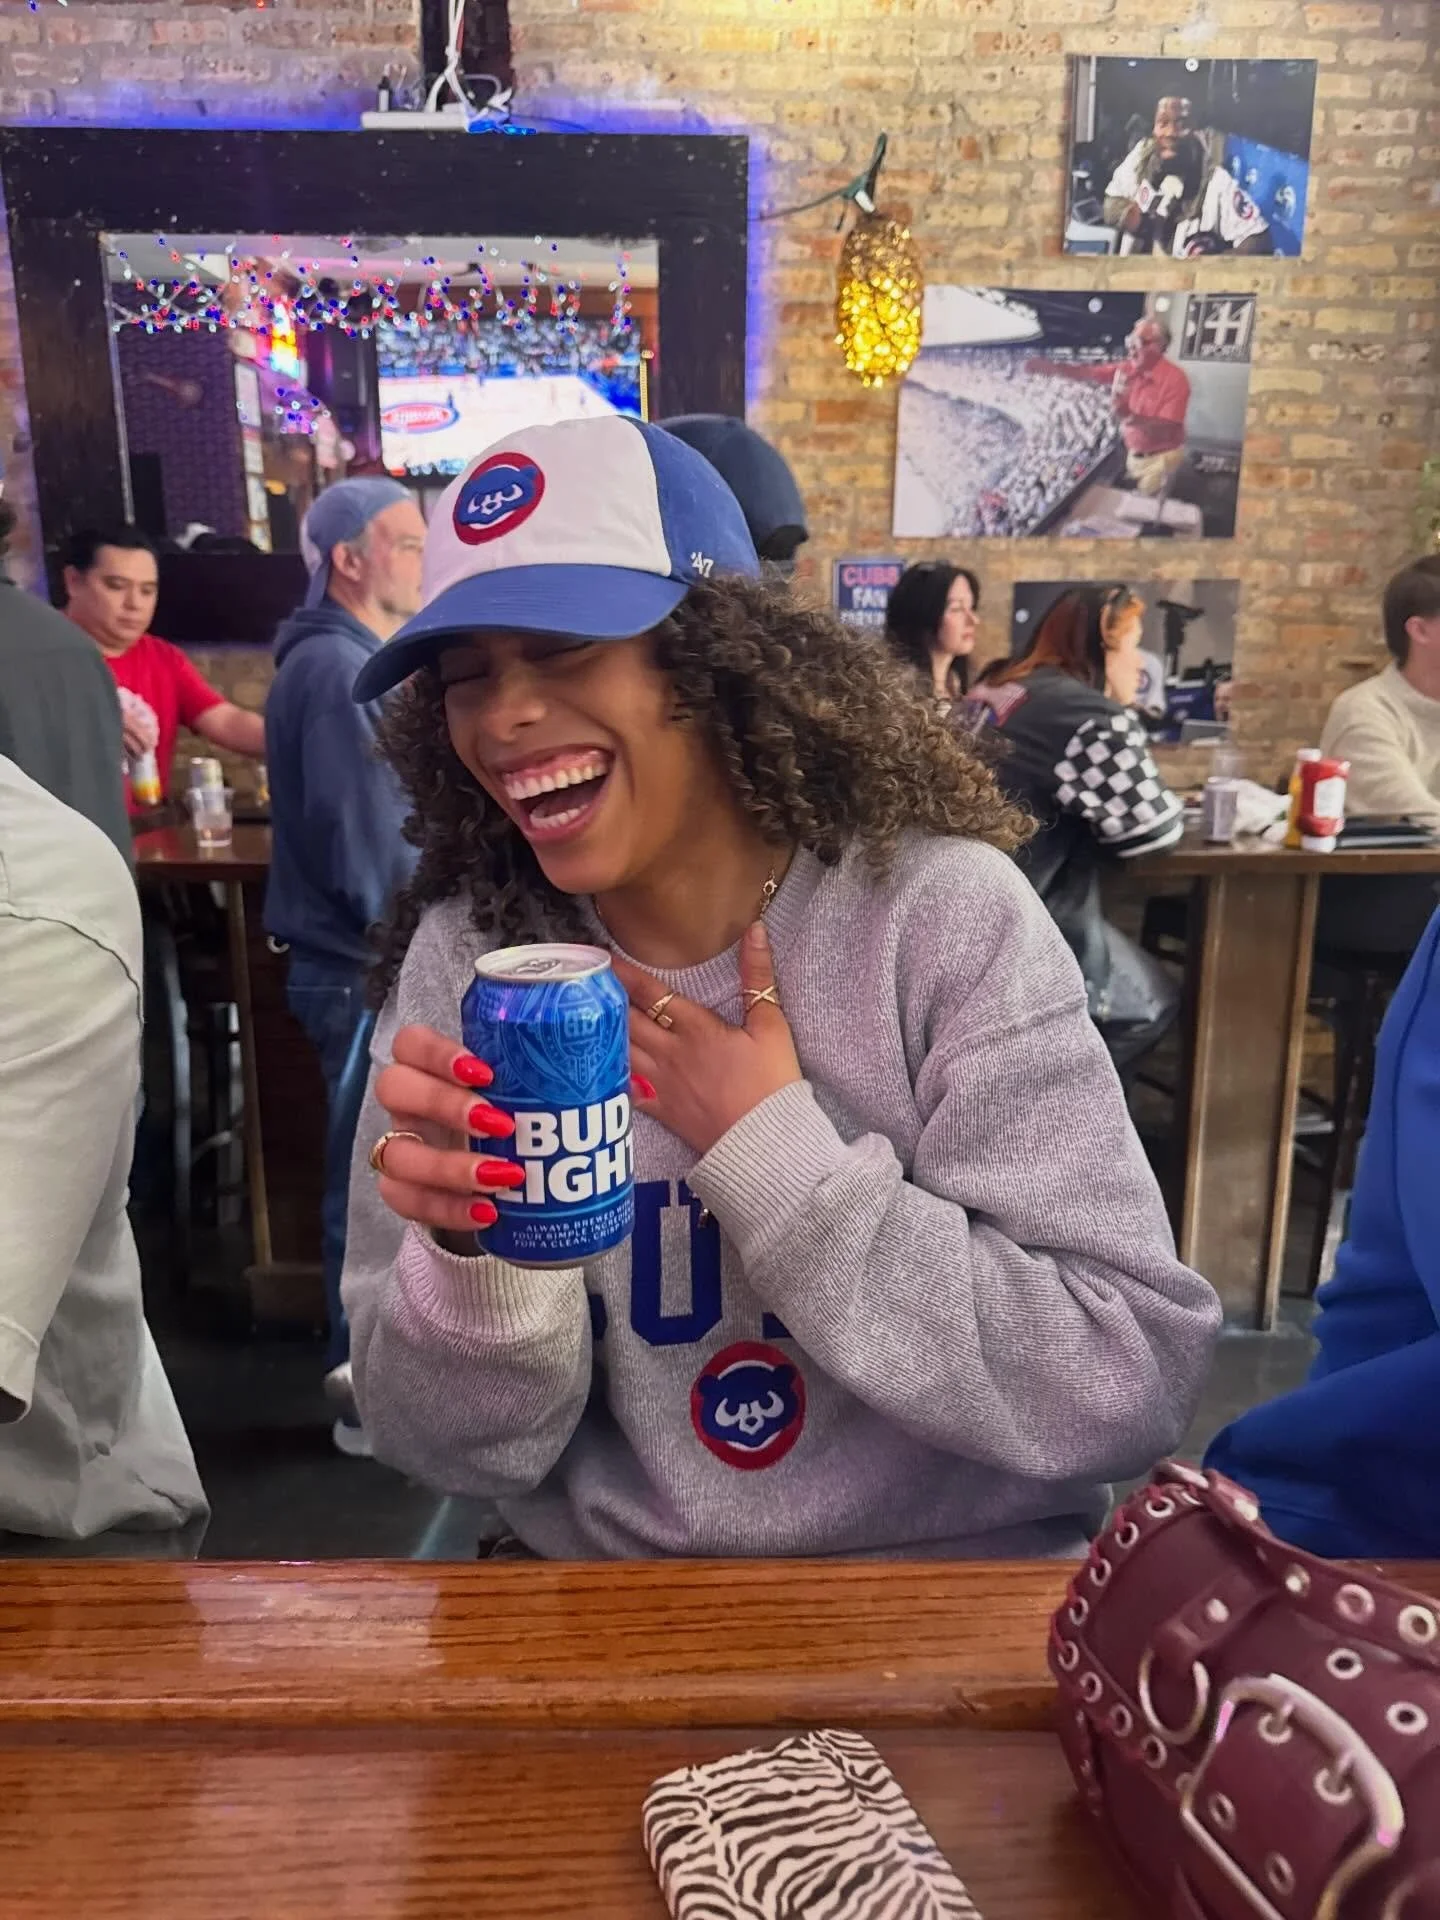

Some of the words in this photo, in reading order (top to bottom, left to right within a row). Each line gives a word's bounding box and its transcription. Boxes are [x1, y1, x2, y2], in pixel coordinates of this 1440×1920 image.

[842, 566, 899, 587] CUBS
[852, 587, 888, 609] FAN
[514, 1093, 630, 1157] BUD
[526, 1223, 570, 1233] ALWAYS
[574, 1210, 615, 1229] BREWED
[512, 1231, 542, 1240] FOUR
[546, 1227, 587, 1240] SIMPLE
[514, 1240, 536, 1248] FOR
[593, 1223, 620, 1240] CRISP
